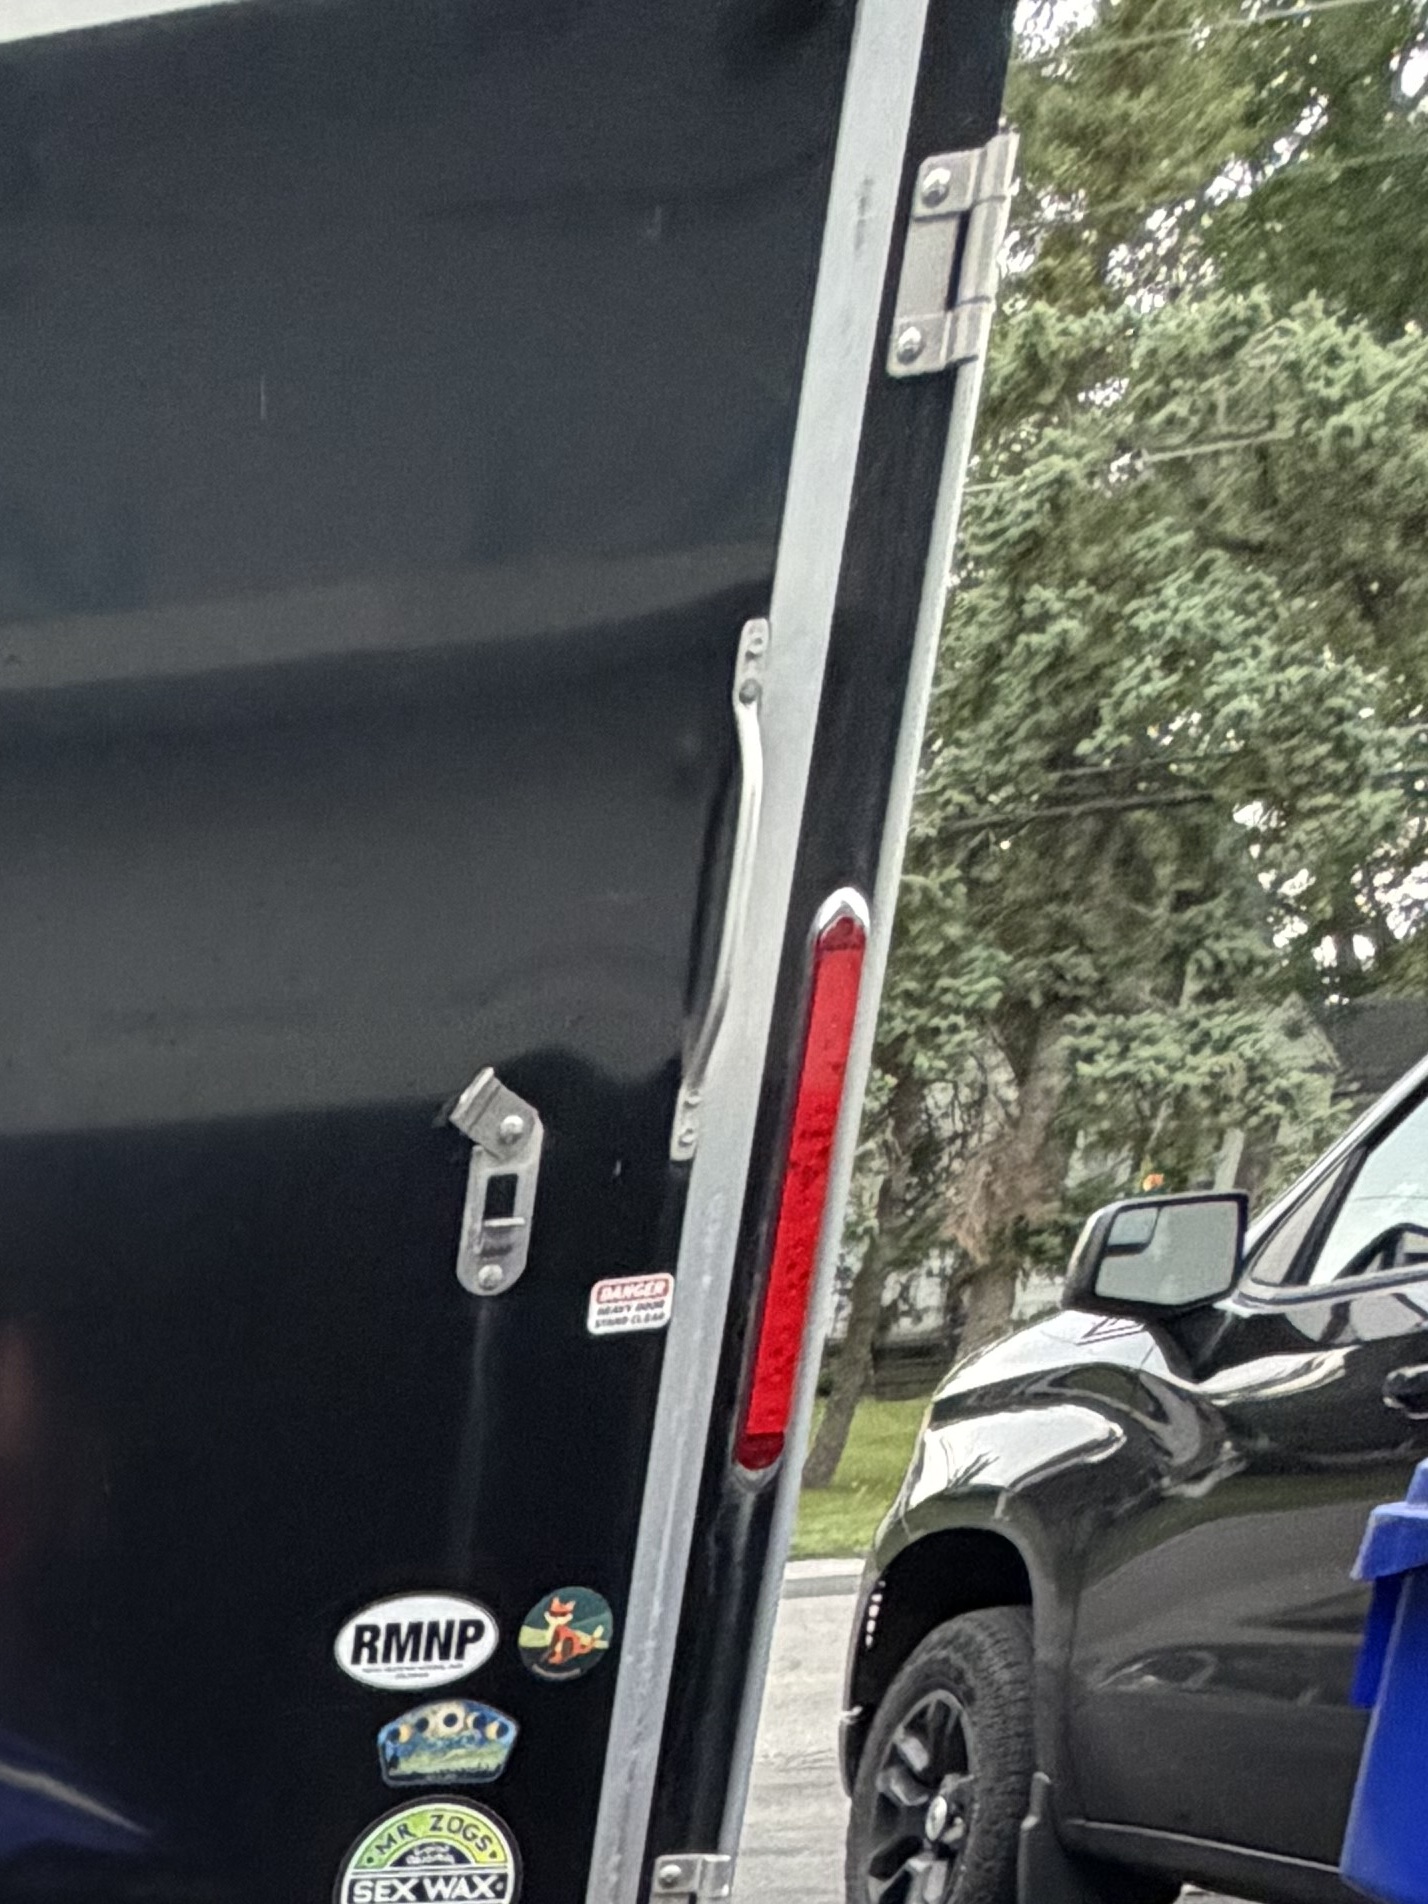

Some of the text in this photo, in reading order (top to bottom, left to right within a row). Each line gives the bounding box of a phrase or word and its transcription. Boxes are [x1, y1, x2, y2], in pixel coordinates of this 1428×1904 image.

[350, 1618, 486, 1666] RMNP
[428, 1813, 494, 1853] ZOGS
[352, 1874, 499, 1904] SEX WAX
